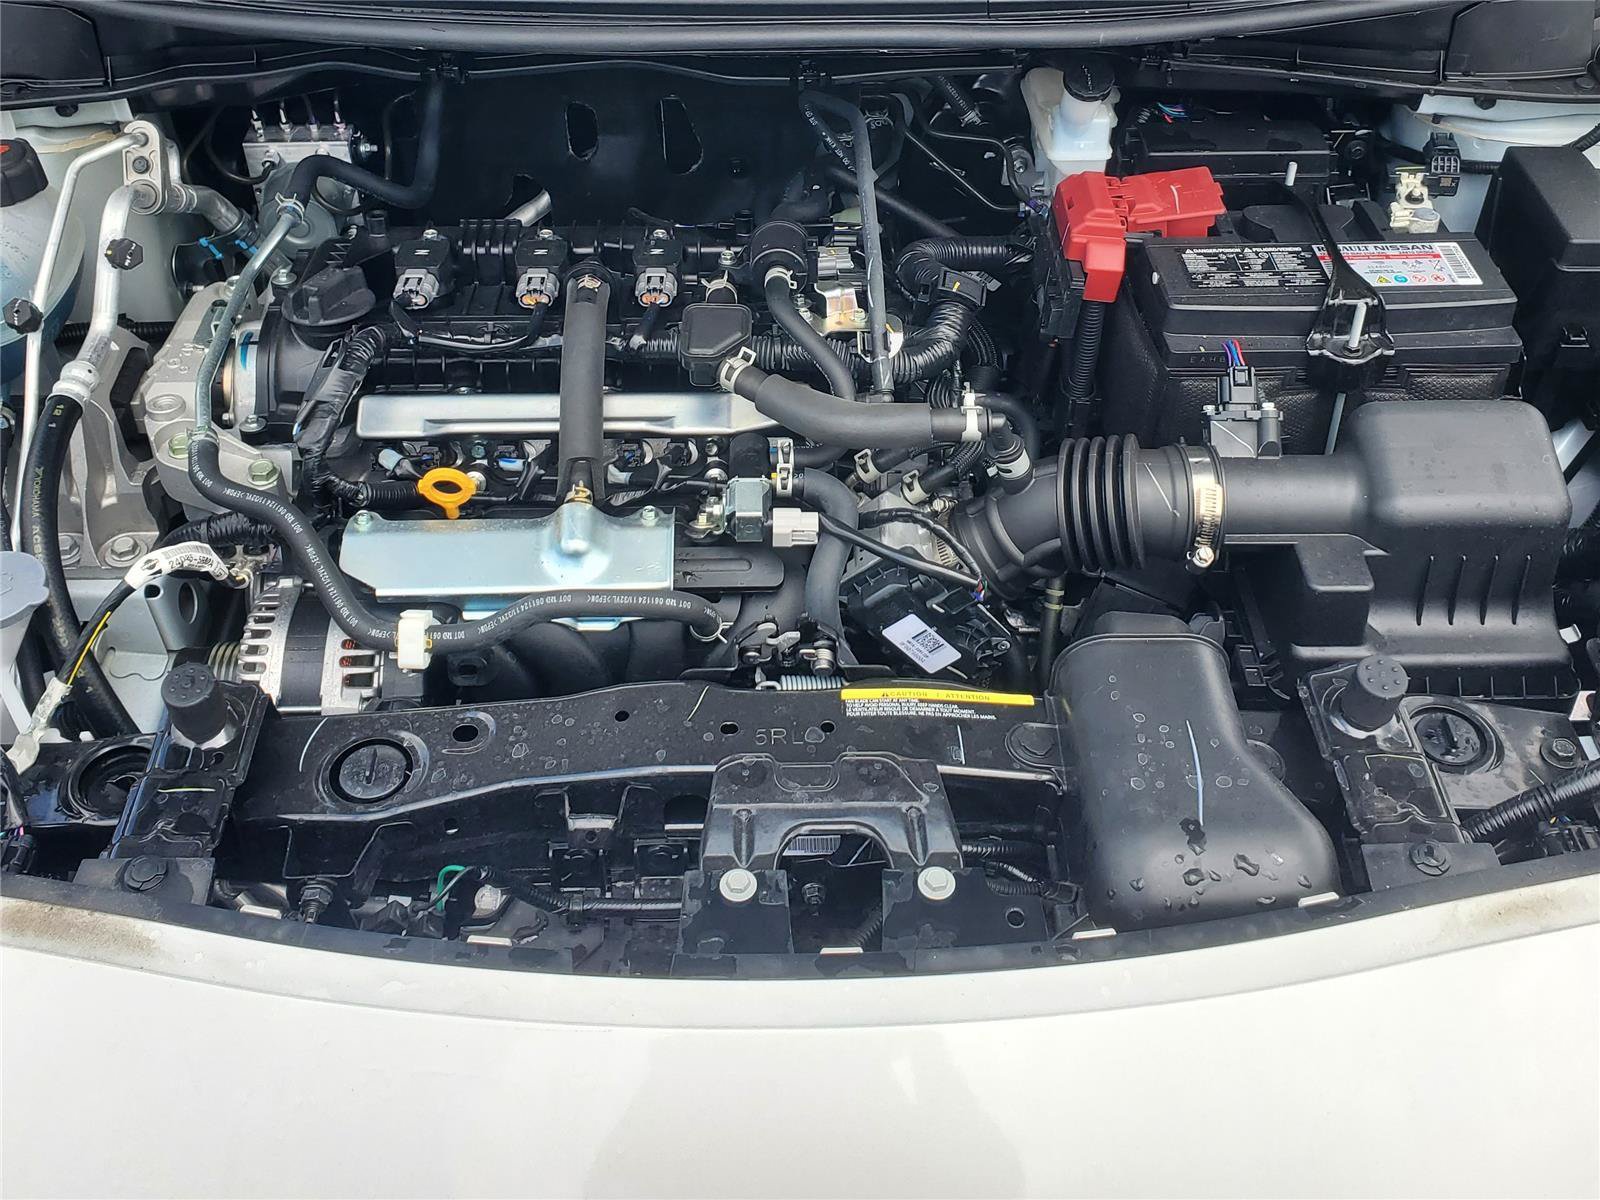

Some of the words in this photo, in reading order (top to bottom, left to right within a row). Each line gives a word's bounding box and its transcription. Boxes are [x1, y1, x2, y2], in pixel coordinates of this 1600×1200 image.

[32, 476, 42, 519] YOKOHAMA
[292, 522, 303, 534] DOT
[558, 594, 572, 602] DOT
[638, 595, 663, 604] 061124
[518, 597, 545, 613] 061124
[679, 600, 691, 608] DOT
[346, 614, 358, 627] DOT
[453, 630, 465, 639] DOT
